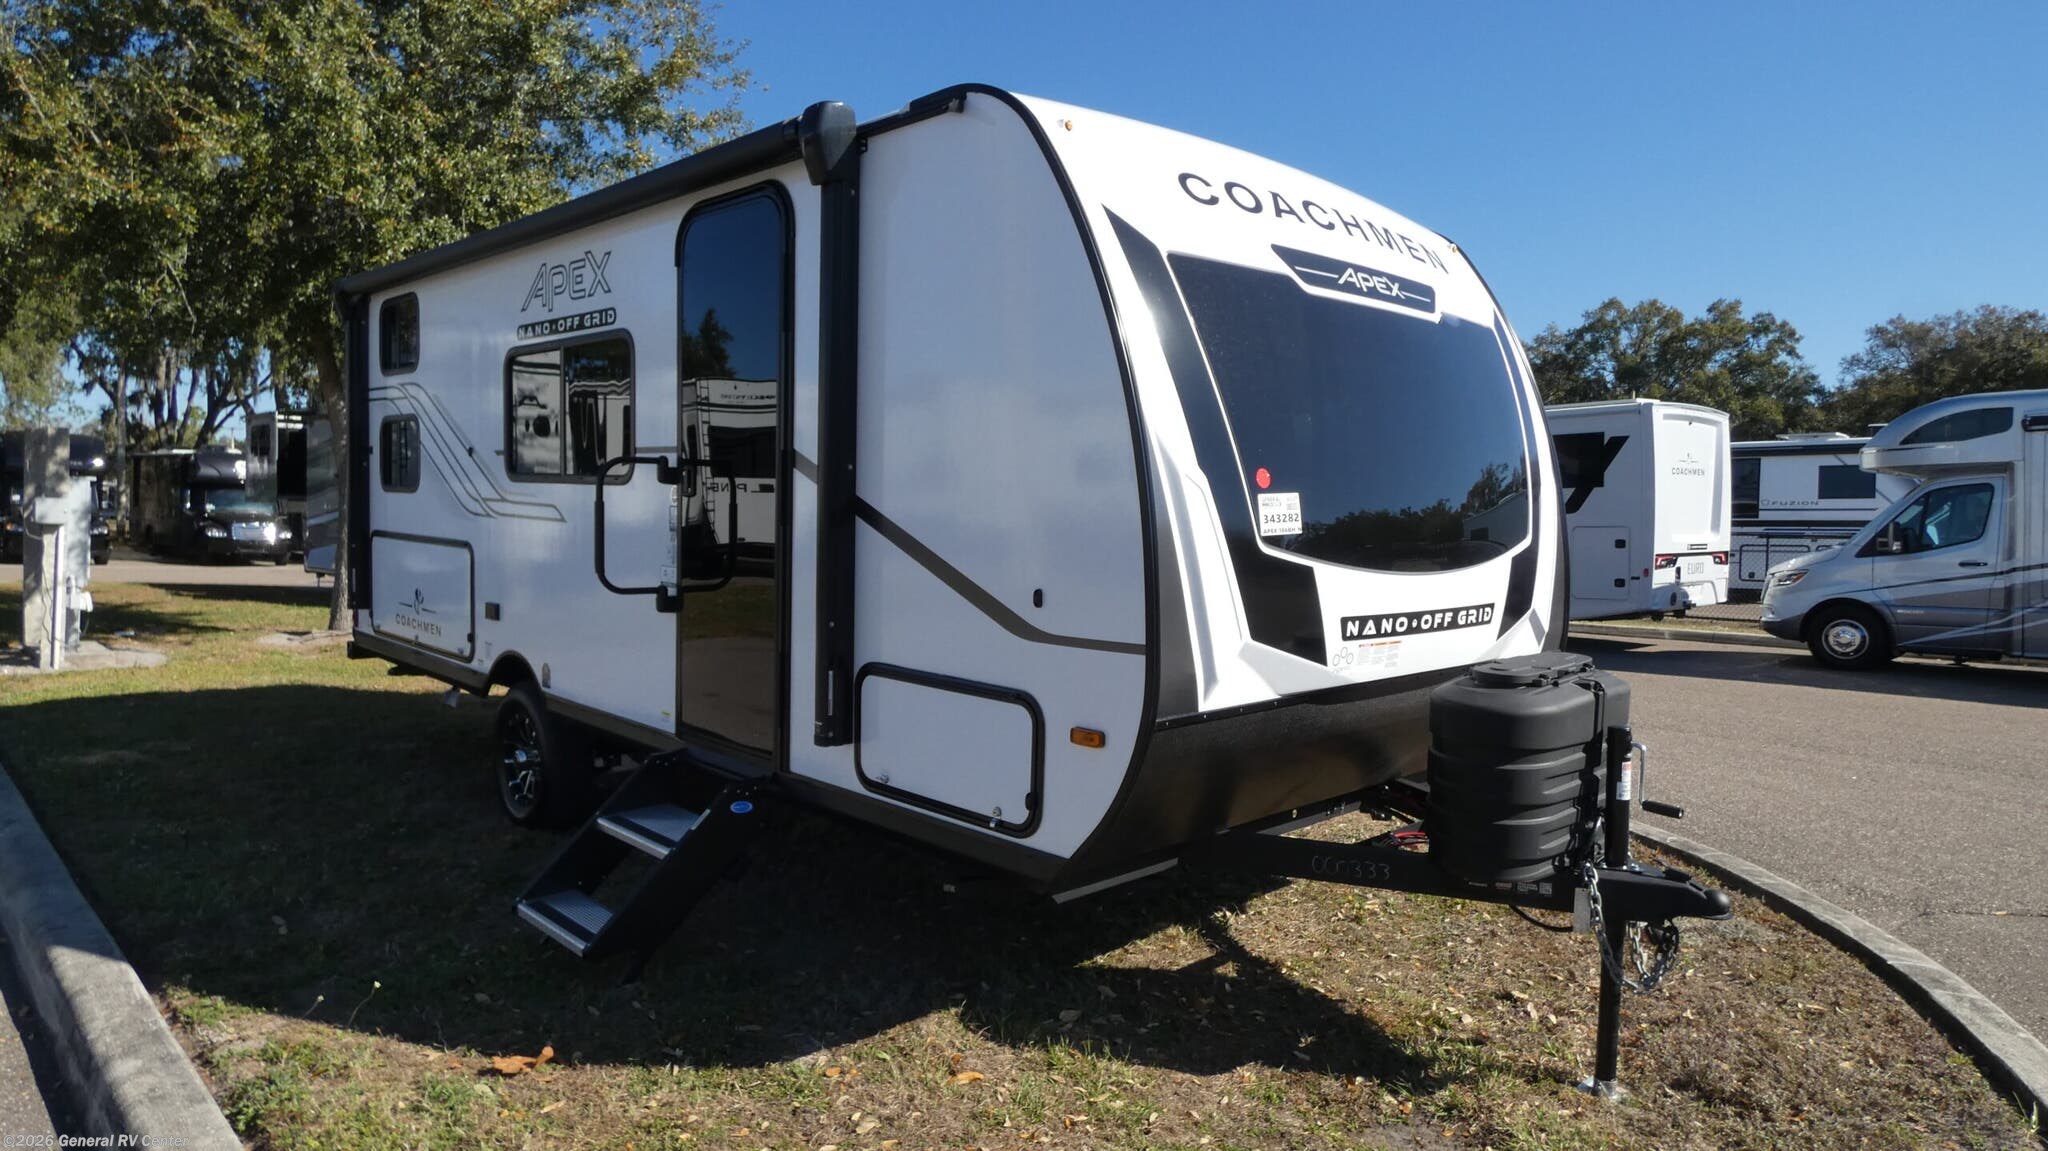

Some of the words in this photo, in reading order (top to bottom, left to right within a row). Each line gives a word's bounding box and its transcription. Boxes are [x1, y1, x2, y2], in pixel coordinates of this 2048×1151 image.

[1177, 172, 1449, 275] COACHMEN
[521, 250, 612, 312] APEX
[1337, 266, 1406, 299] APEX
[518, 322, 550, 338] NANO
[557, 315, 580, 331] OFF
[583, 309, 615, 327] GRID
[1671, 467, 1705, 476] COACHMEN
[1263, 512, 1300, 524] 343282
[395, 613, 442, 637] COACHMEN
[1345, 616, 1409, 637] NANO
[1420, 612, 1453, 630] OFF
[1457, 606, 1492, 625] GRID
